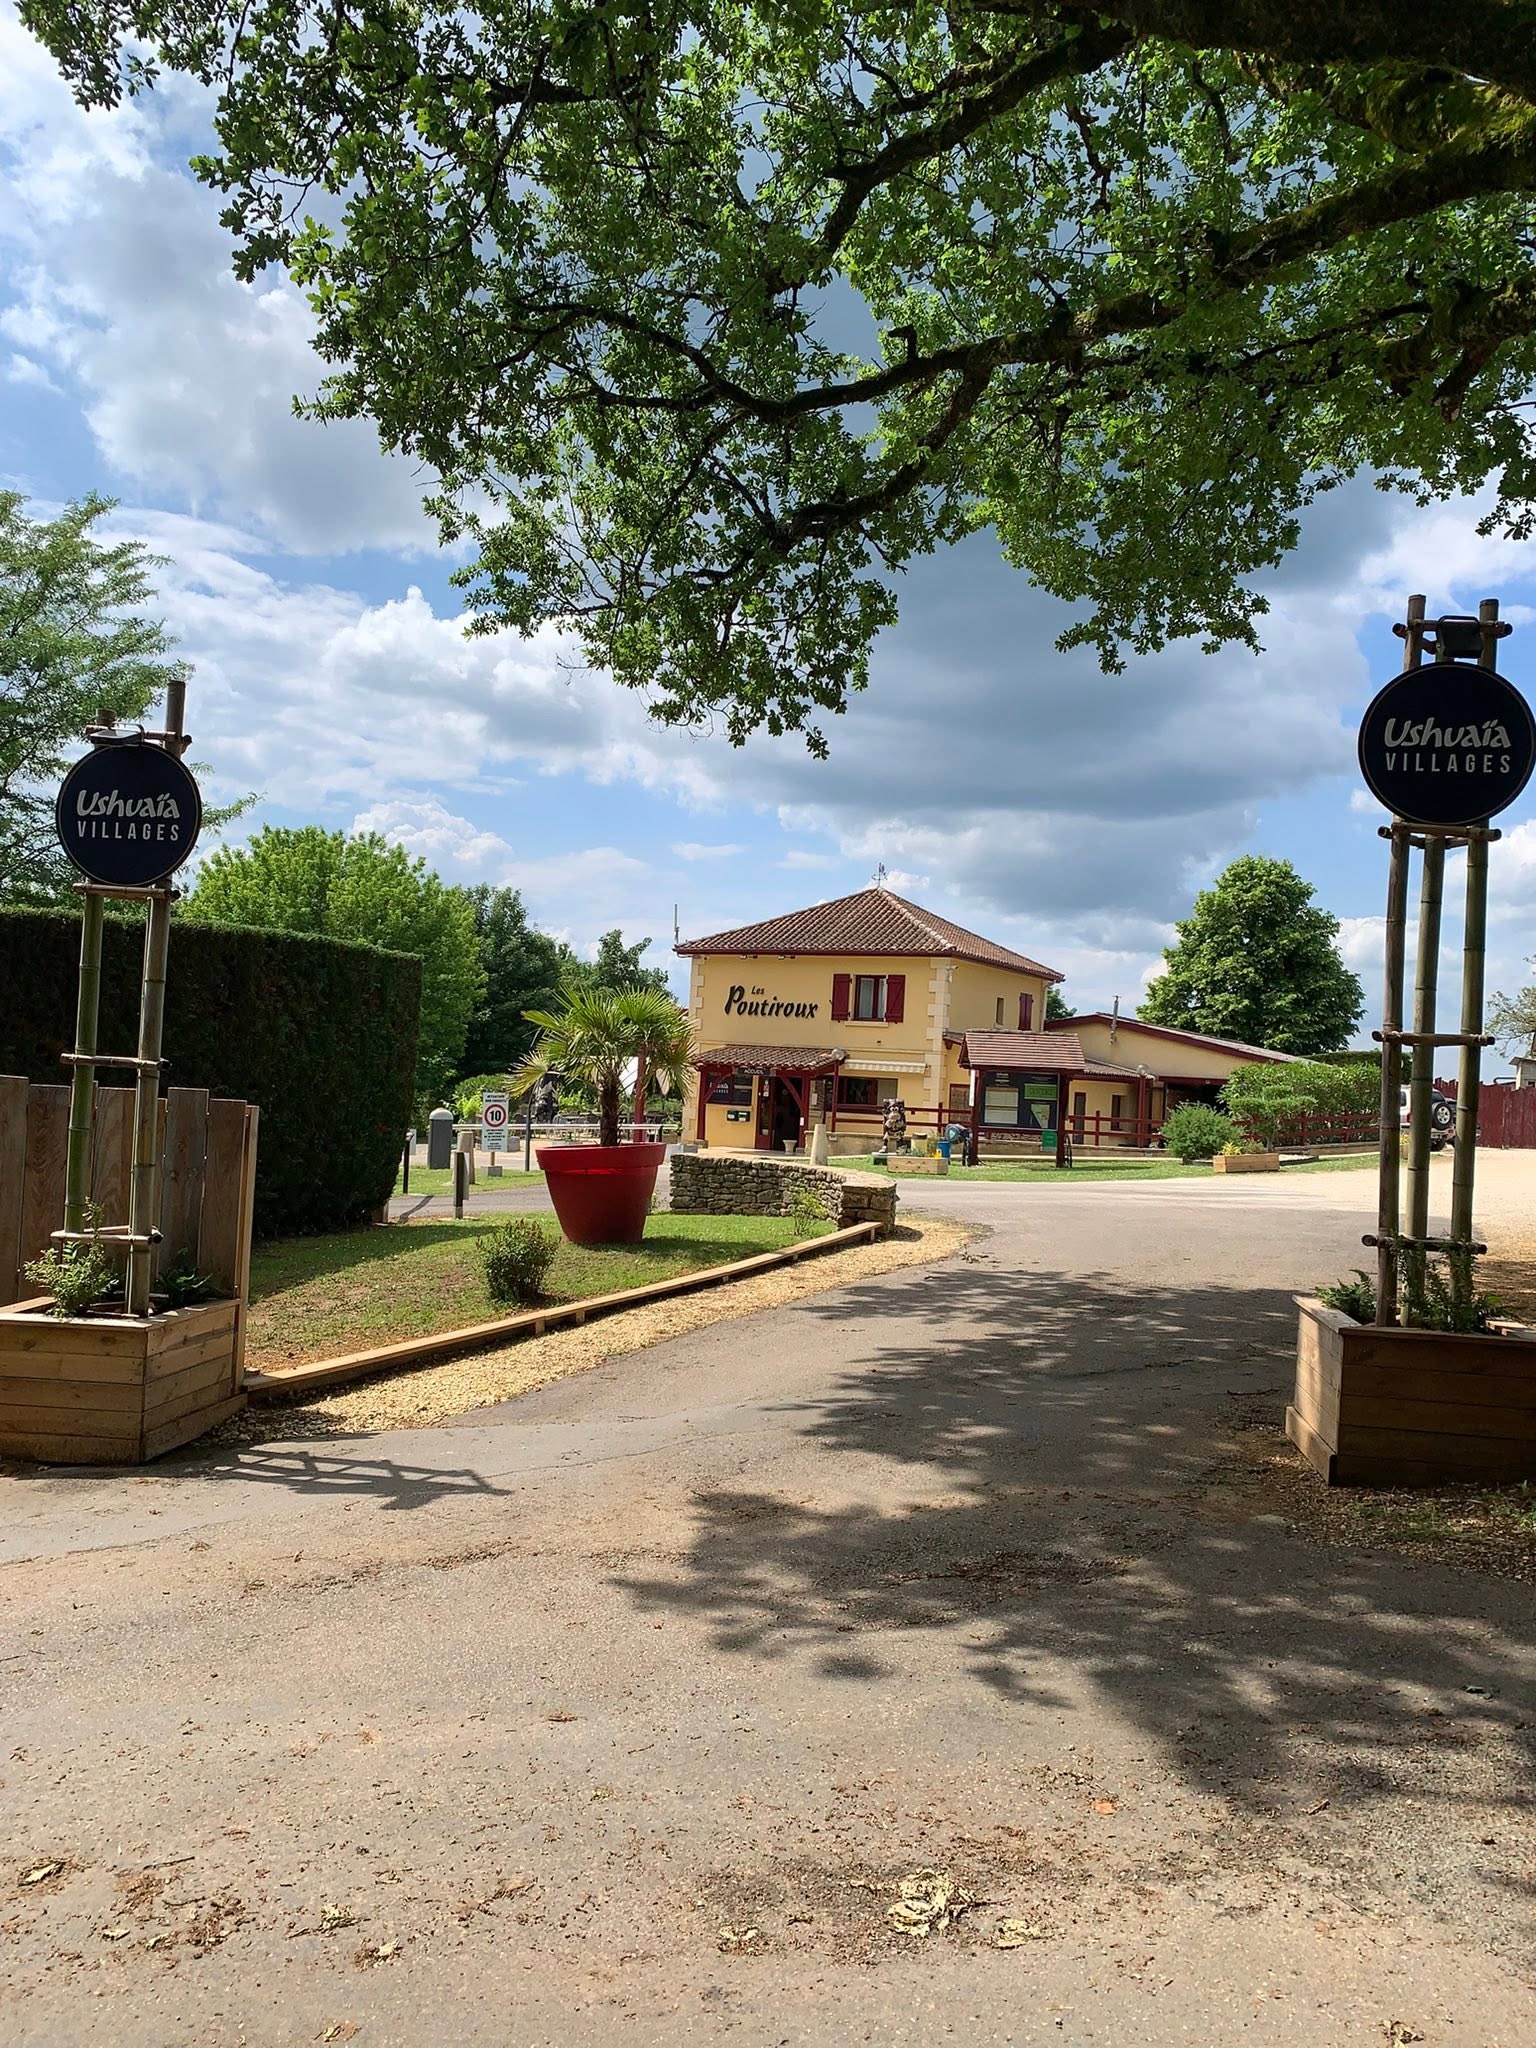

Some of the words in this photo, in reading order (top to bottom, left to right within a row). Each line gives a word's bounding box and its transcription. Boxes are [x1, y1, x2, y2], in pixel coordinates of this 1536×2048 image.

[1384, 717, 1511, 748] Ushuaïa
[1385, 752, 1511, 773] VILLAGES
[76, 789, 180, 818] Ushuaïa
[77, 820, 179, 841] VILLAGES
[750, 985, 765, 995] Les
[724, 985, 819, 1019] Poutiroux
[489, 1110, 501, 1122] 10
